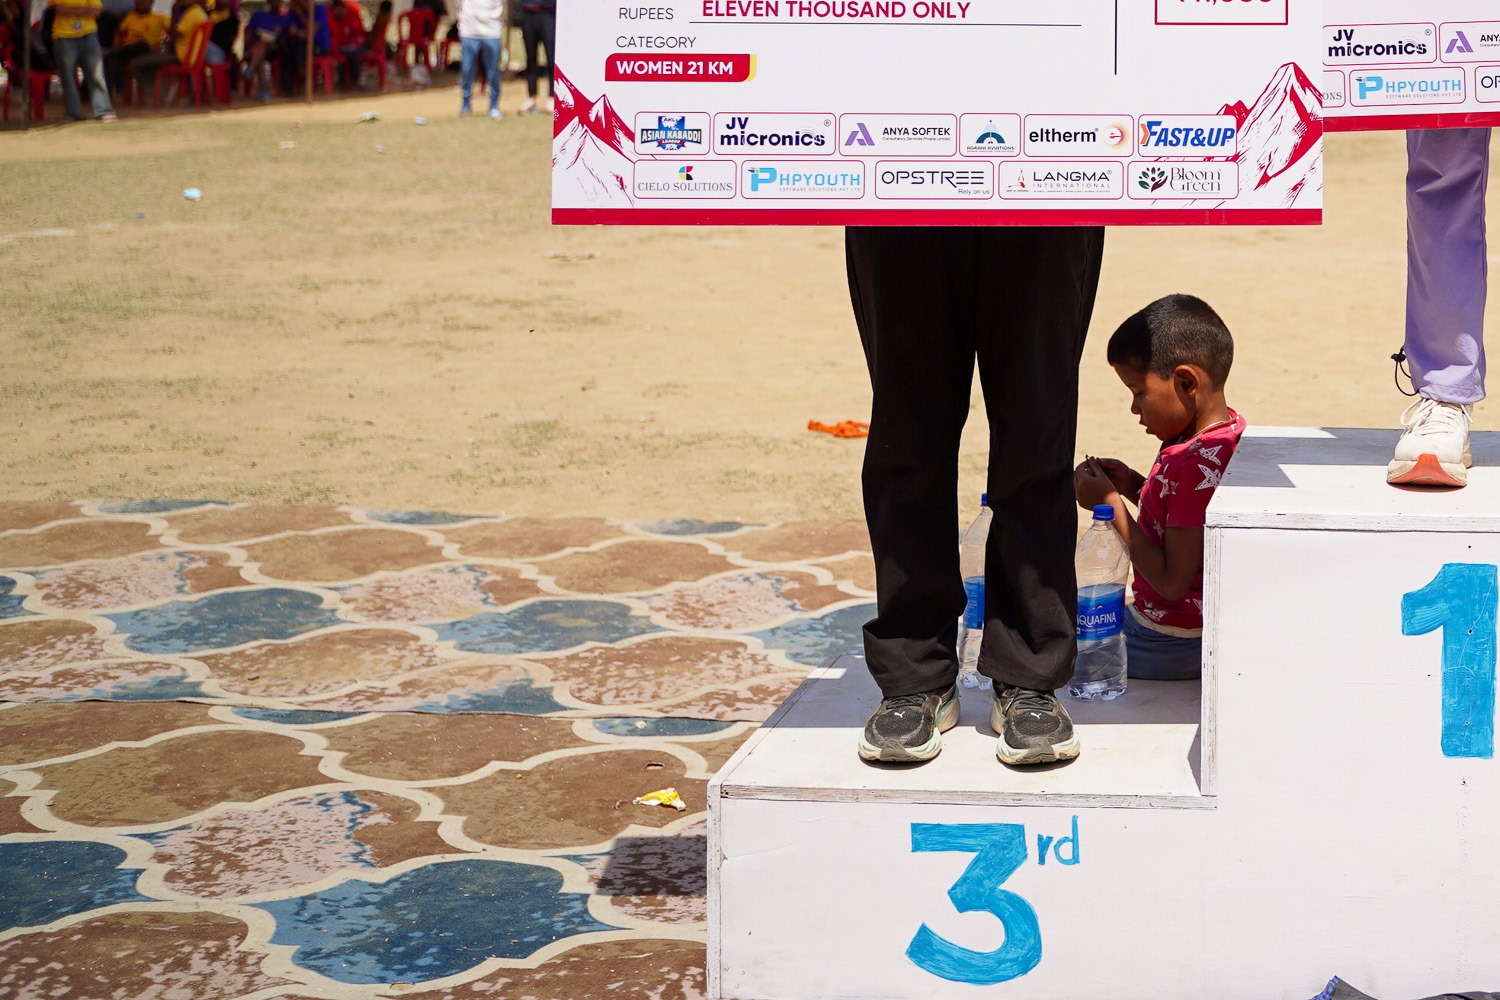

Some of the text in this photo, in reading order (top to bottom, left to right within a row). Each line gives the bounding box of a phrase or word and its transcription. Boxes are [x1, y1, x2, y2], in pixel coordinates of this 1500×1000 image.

[619, 0, 971, 20] RUPEES ELEVEN THOUSAND ONLY
[1333, 29, 1354, 41] JV
[616, 36, 696, 48] CATEGORY
[1328, 41, 1427, 57] micronics
[616, 61, 733, 75] WOMEN 21 KM
[1357, 76, 1461, 99] PHPYOUTH
[726, 117, 749, 130] JV
[641, 130, 701, 143] ASIAN KABADDI
[882, 127, 951, 136] ANYA SOFTEK
[1029, 128, 1096, 142] eltherm
[1142, 121, 1235, 147] FAST&UP
[720, 131, 825, 146] micronics
[749, 167, 860, 192] PHPYOUTH
[881, 171, 984, 188] OPSTREE
[1033, 171, 1110, 182] LANGMA
[1170, 167, 1220, 180] Bloom
[638, 182, 733, 192] CIELO SOLUTIONS
[1170, 179, 1220, 191] Green
